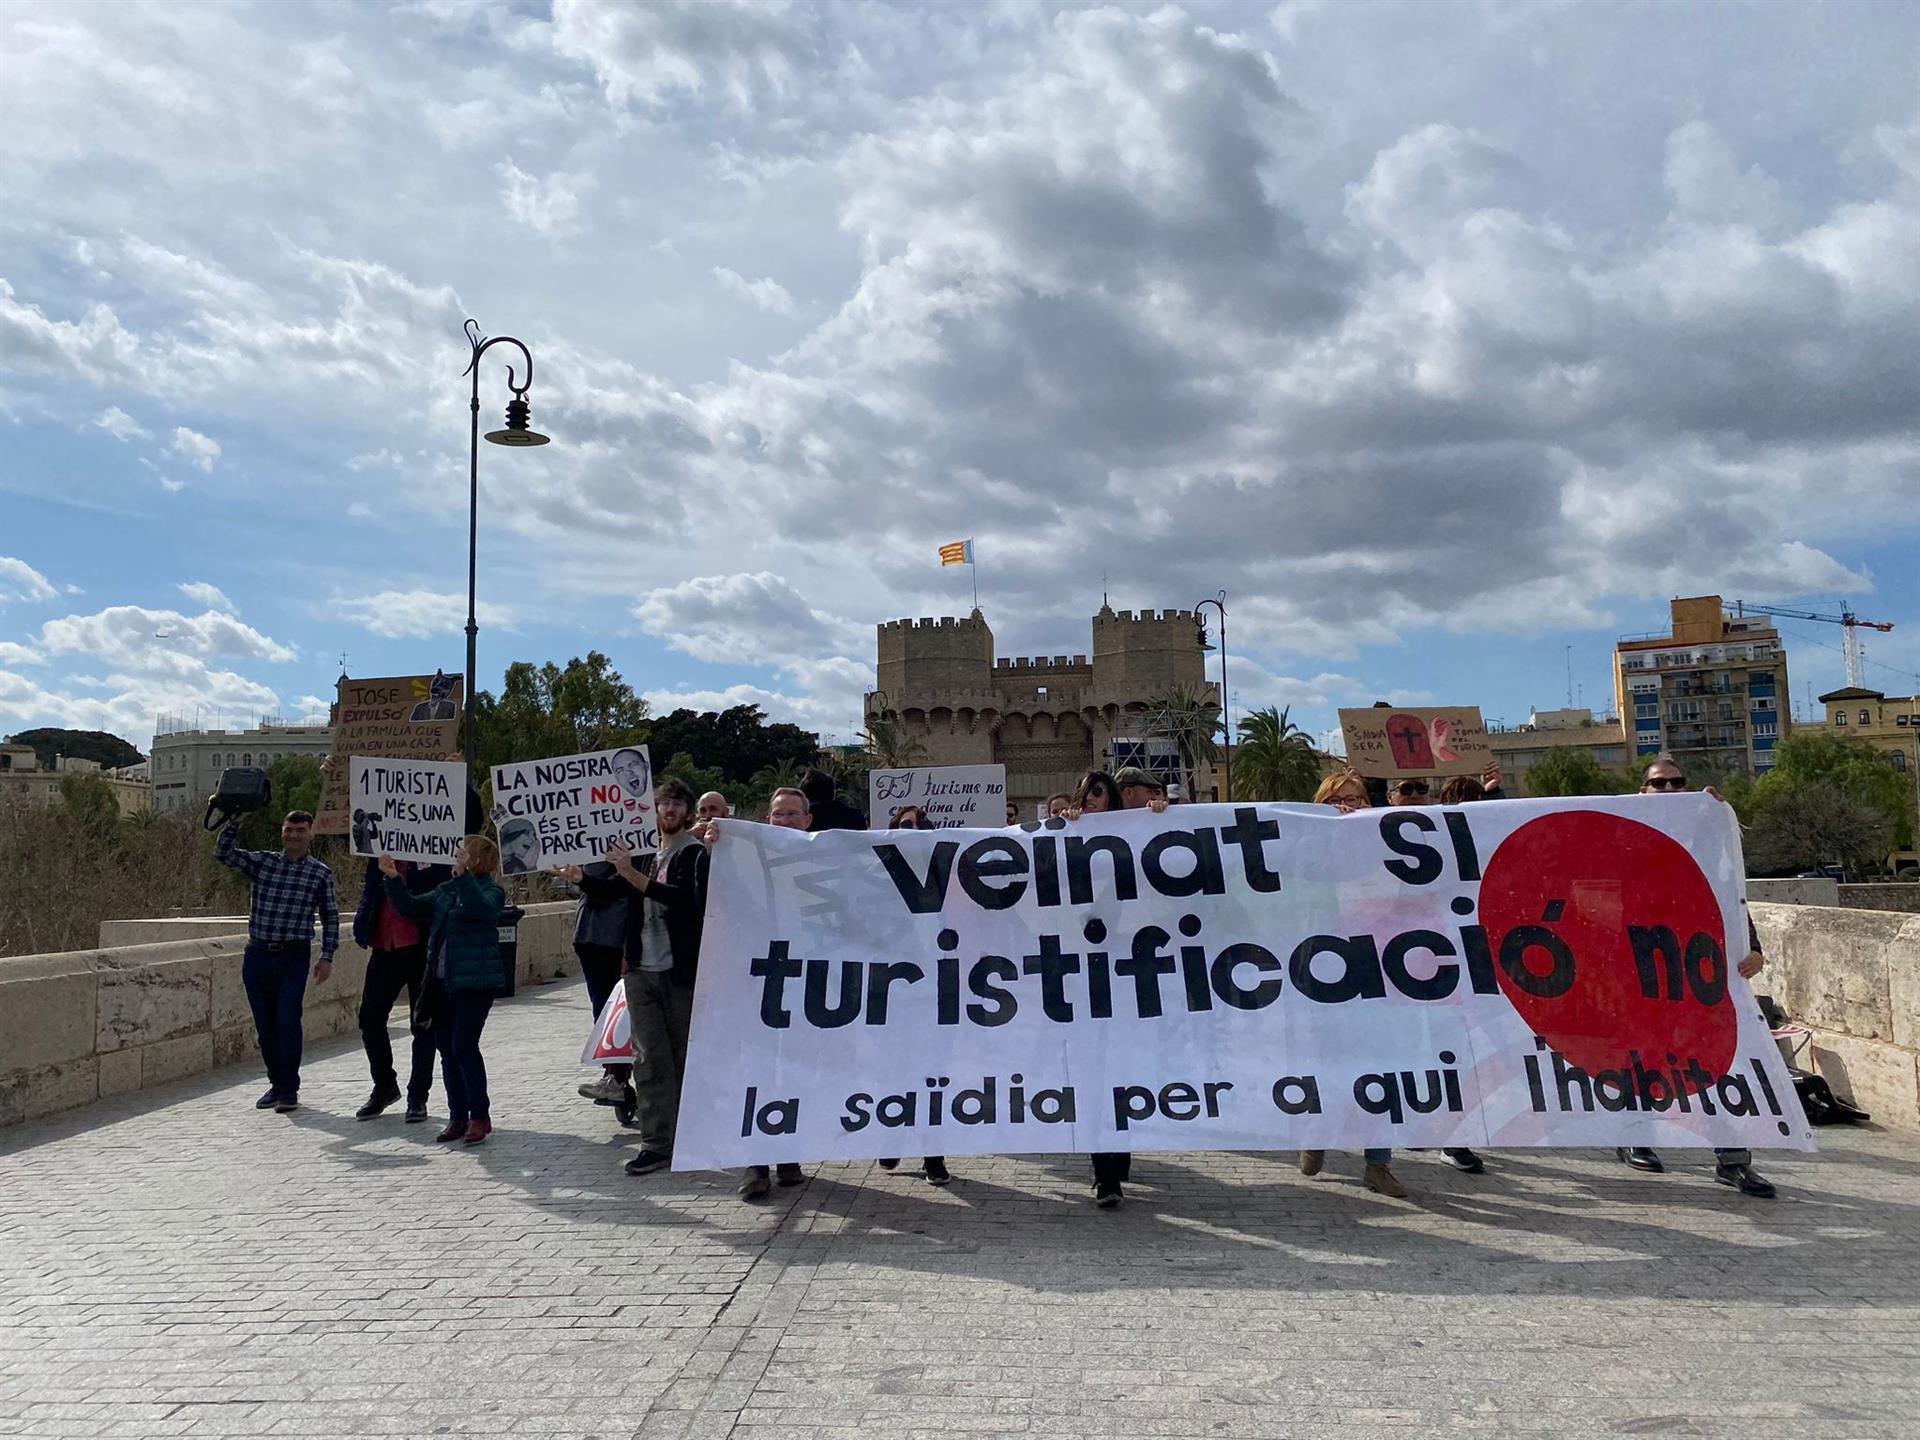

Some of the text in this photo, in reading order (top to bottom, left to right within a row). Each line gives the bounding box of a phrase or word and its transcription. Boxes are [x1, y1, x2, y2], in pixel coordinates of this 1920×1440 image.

[350, 687, 400, 708] JOSE
[350, 726, 363, 737] LA
[415, 725, 444, 737] QUE
[386, 739, 408, 749] UNA
[409, 738, 442, 749] CASA
[360, 768, 450, 798] 1 TURISTA
[497, 756, 611, 791] LA NOSTRA
[922, 772, 981, 797] turisme
[986, 784, 1004, 794] no
[508, 784, 621, 815] CIUTAT NO
[960, 797, 977, 812] de
[539, 808, 624, 833] ÉS EL TEU
[378, 828, 419, 854] VEÏNA
[542, 830, 586, 855] PARC
[872, 807, 1281, 914] veïnat
[750, 896, 1729, 1029] turistificació no
[741, 1035, 1792, 1138] la saïdia per a qui l'habita!
